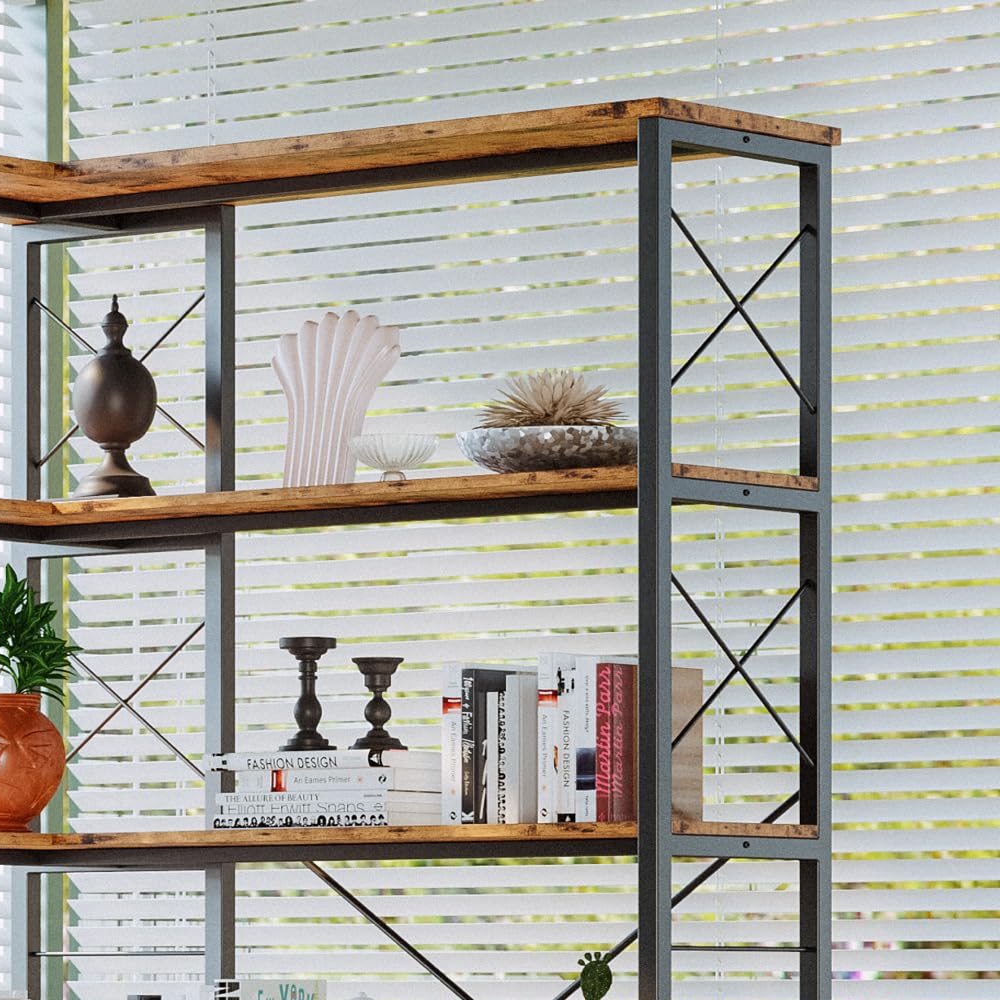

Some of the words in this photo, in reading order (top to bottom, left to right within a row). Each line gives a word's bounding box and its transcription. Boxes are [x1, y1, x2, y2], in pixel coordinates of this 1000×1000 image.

[596, 666, 612, 718] Parr
[611, 668, 622, 716] Parr
[247, 757, 294, 770] FASHION
[298, 756, 338, 769] DESIGN
[596, 722, 612, 798] Martin
[612, 724, 624, 798] Martin
[328, 776, 351, 784] Primer
[228, 804, 265, 816] Elliott
[270, 803, 310, 815] Erwitt
[316, 802, 364, 814] Snaps
[274, 794, 285, 802] OF
[286, 794, 320, 802] BEAUTY
